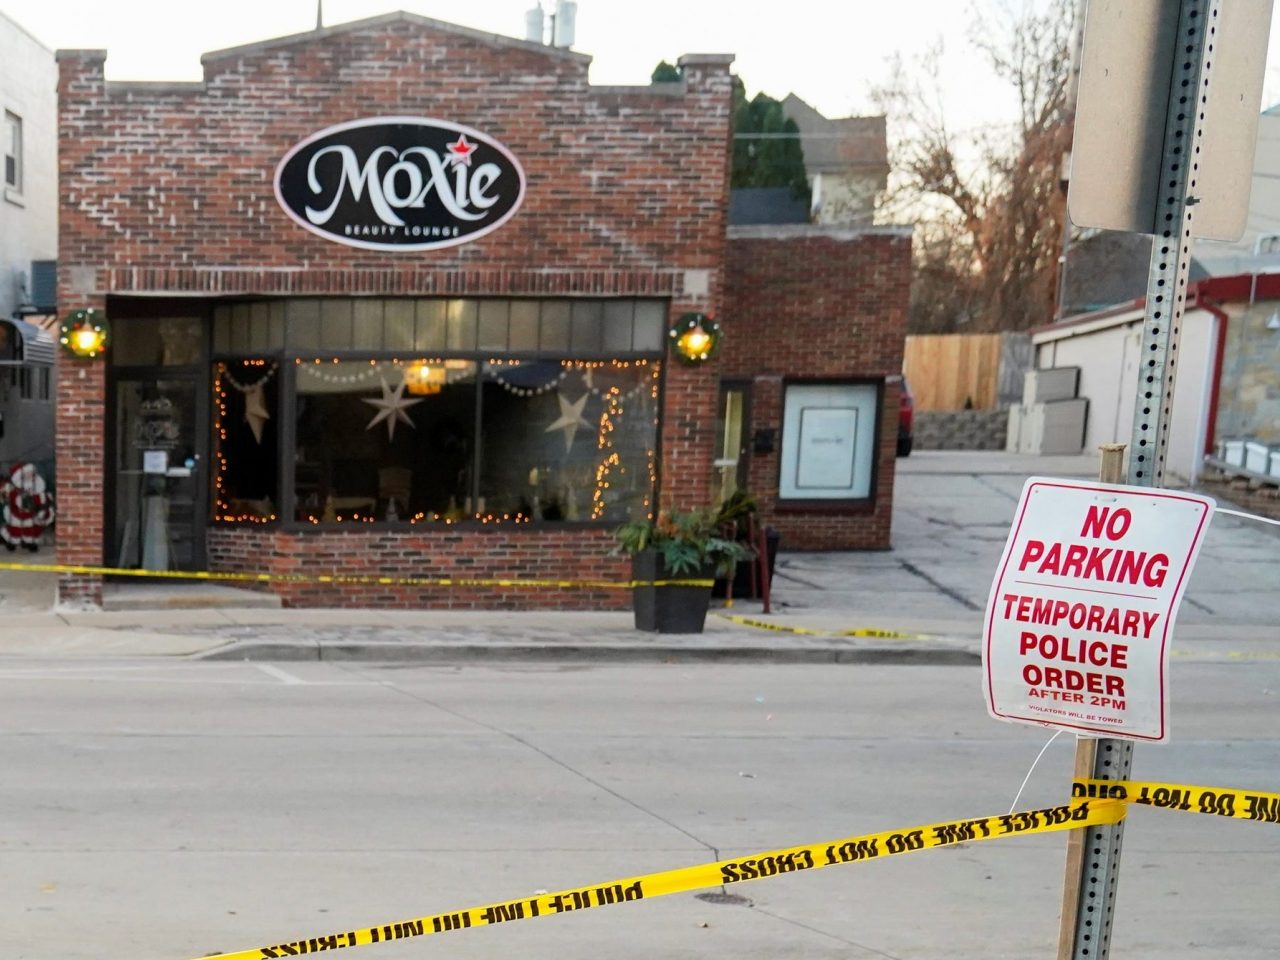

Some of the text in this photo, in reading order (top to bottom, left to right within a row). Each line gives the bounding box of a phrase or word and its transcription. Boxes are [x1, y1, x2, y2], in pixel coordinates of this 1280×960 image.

[345, 225, 459, 237] BEAUTY LOUNGE
[1081, 506, 1132, 540] NO
[1019, 540, 1169, 587] PARKING
[1003, 594, 1159, 638] TEMPORARY
[1020, 632, 1128, 669] POLICE
[1023, 664, 1125, 696] ORDER
[1028, 689, 1126, 710] AFTER 2PM
[1028, 705, 1066, 715] VIOLATORS
[1068, 711, 1084, 719] WILL
[1098, 716, 1123, 724] TOWED
[1136, 788, 1191, 810] NOT
[1199, 792, 1235, 816] DO
[721, 802, 1089, 884] POLICE LINE DO NOT CROSS
